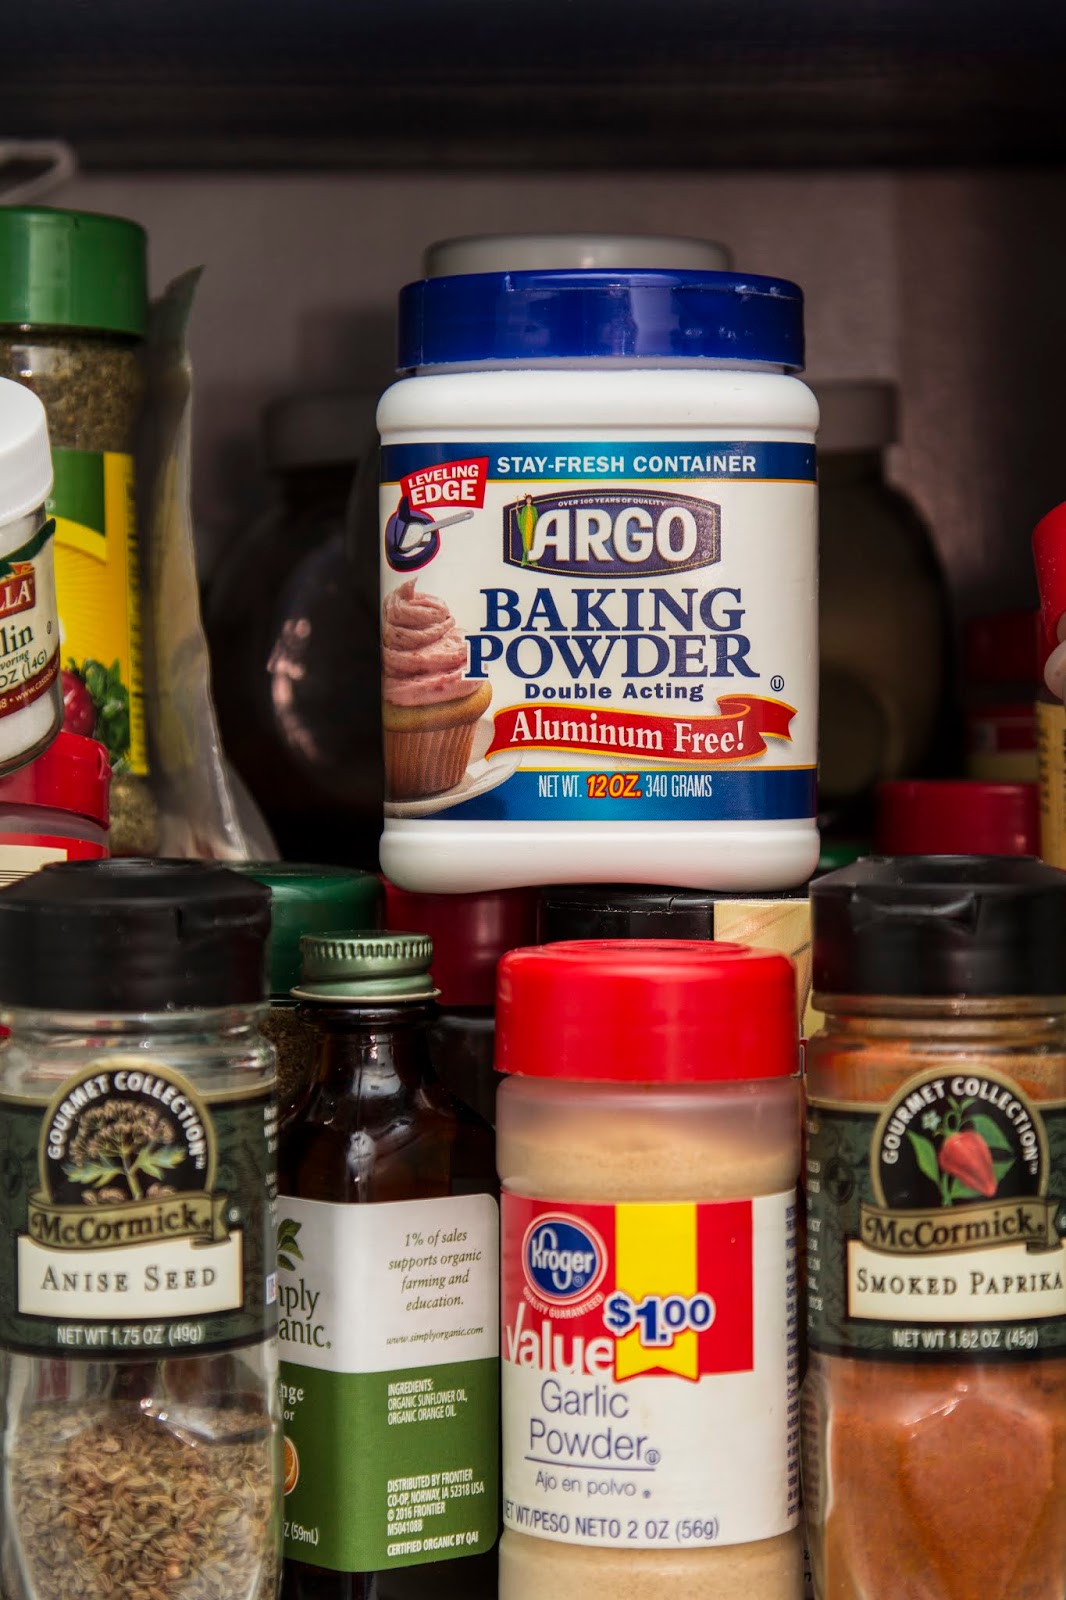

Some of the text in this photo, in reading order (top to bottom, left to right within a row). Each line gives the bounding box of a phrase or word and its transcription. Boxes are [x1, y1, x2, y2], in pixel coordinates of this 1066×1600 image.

[408, 464, 479, 489] LEVELING
[497, 456, 757, 473] STAY-FRESH CONTAINER
[411, 480, 477, 505] EDGE
[558, 499, 578, 507] OVER
[633, 498, 665, 507] QUALITY
[528, 506, 697, 562] ARGO
[0, 579, 31, 611] LA
[479, 587, 745, 632] BAKING
[464, 634, 760, 679] POWDER
[525, 683, 705, 703] Double Acting
[510, 709, 745, 754] Aluminum Free!
[538, 774, 559, 798] NET
[561, 774, 582, 798] WT.
[645, 775, 668, 798] 340
[671, 775, 712, 798] GRAMS
[48, 1076, 110, 1160] GOURMET
[881, 1079, 946, 1165] GOURMET
[405, 1228, 467, 1248] 1% of sales
[388, 1249, 482, 1272] supports organic
[531, 1227, 594, 1290] Kroger
[41, 1265, 216, 1293] ANISE SEED
[401, 1269, 470, 1294] farming and
[406, 1294, 464, 1312] education.
[523, 1286, 604, 1319] QUALITY GUARANTEED
[605, 1293, 713, 1344] $1.00
[57, 1325, 202, 1345] NET WT 1.75 OZ (49g)
[386, 1325, 484, 1345] www.simplyorganic.com
[892, 1328, 1039, 1350] NET WT 1.62 OZ (45g)
[388, 1379, 434, 1396] INGREDIENTS:
[388, 1388, 468, 1411] ORGANIC SUNFLOWER OIL,
[541, 1379, 629, 1418] Garlic
[388, 1409, 417, 1425] ORGANIC
[418, 1406, 444, 1420] ORANGE
[530, 1418, 648, 1461] Powder
[387, 1469, 473, 1493] DISTRIBUTED BY FRONTIER
[535, 1470, 636, 1498] Ajo en polvo
[387, 1481, 485, 1507] CO-OP, NORWAY, IA 52318 USA
[395, 1506, 412, 1521] 2016
[413, 1501, 446, 1518] FRONTIER
[516, 1504, 569, 1534] WT/PESO
[575, 1517, 621, 1539] NETO
[627, 1520, 638, 1538] 2
[645, 1520, 669, 1540] OZ
[675, 1516, 719, 1541] (56g)
[291, 1521, 319, 1546] (59mL)
[387, 1531, 479, 1556] CERTIFIED ORGANIC BY QAI
